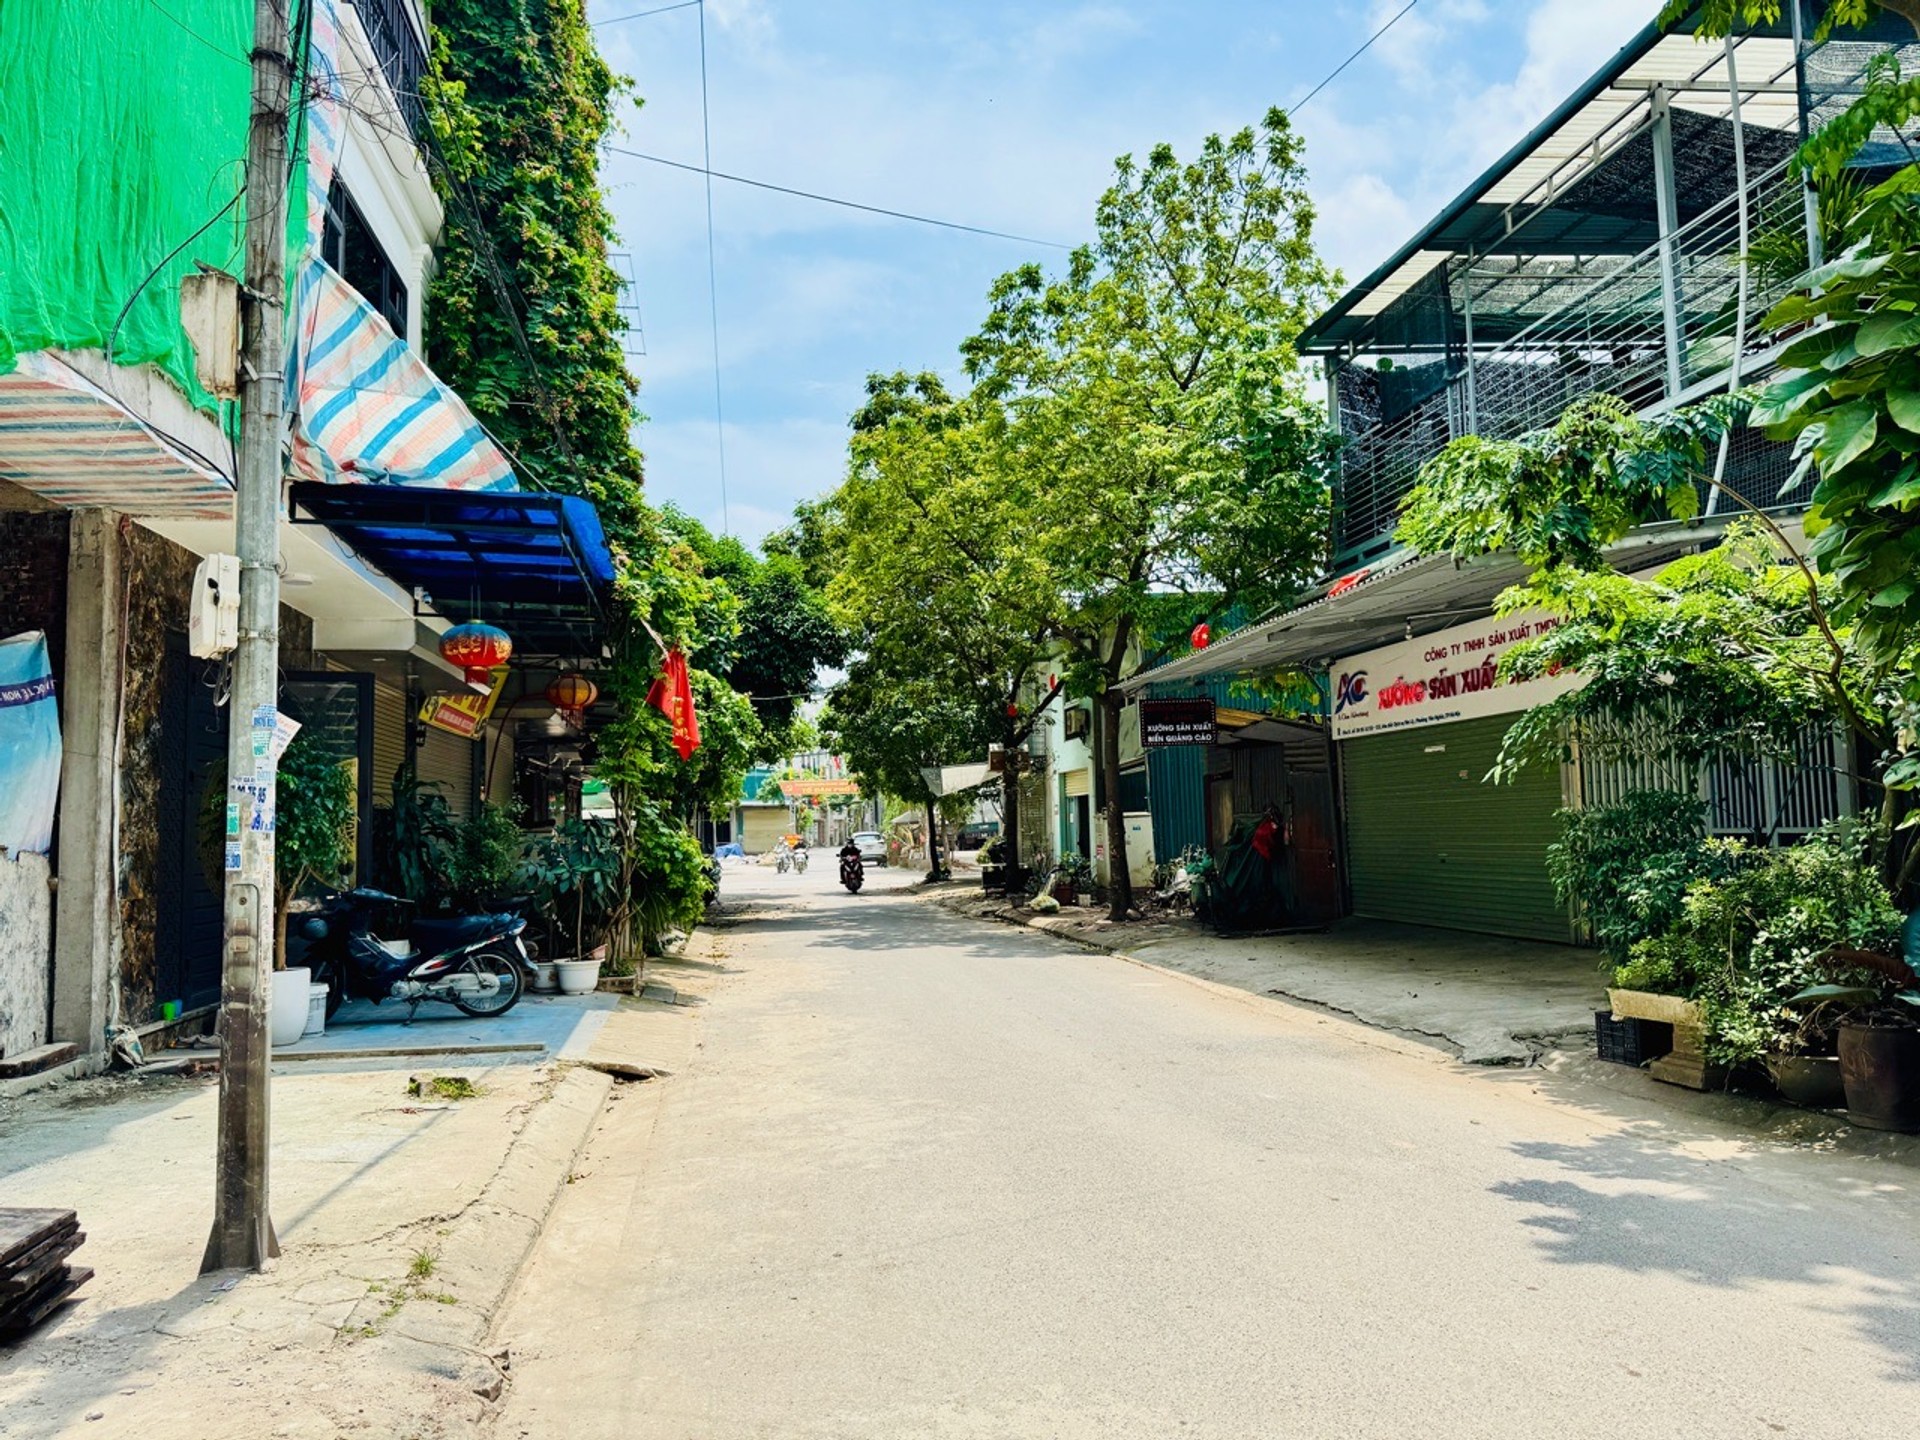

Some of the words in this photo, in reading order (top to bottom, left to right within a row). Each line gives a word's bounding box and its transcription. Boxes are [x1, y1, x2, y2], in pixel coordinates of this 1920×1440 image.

[1424, 646, 1447, 662] CÔNG
[1451, 643, 1461, 656] TY
[1463, 637, 1485, 652] TNHH
[1488, 630, 1505, 646] SẢN
[1508, 620, 1530, 641] XUẤT
[1429, 668, 1457, 700] SẢN
[1176, 722, 1190, 731] SẢN
[1193, 721, 1212, 731] XUẤT
